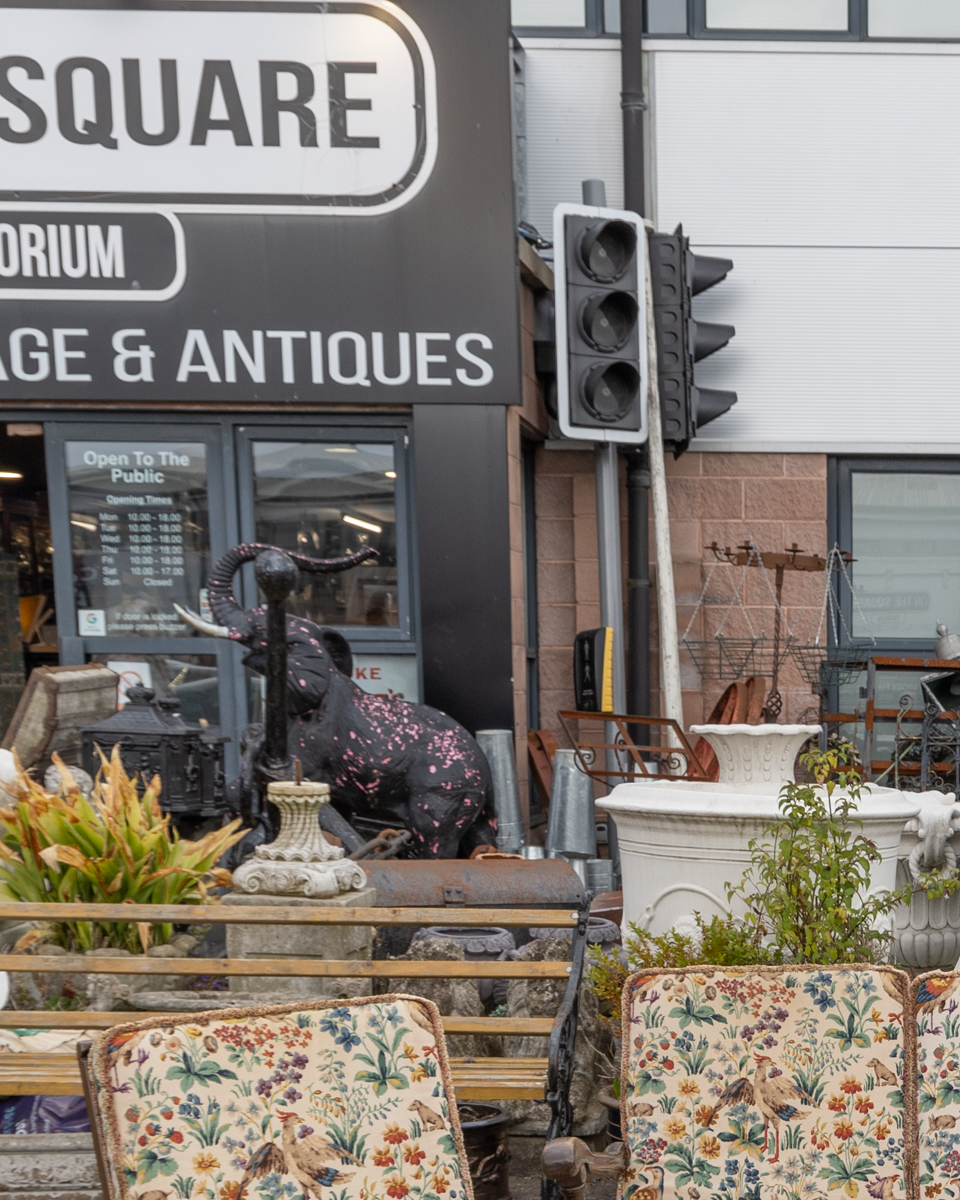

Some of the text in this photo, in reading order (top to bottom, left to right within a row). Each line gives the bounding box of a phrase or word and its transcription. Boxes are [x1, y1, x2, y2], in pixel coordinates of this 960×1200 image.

[0, 56, 381, 150] SQUARE
[111, 328, 155, 382] &
[176, 329, 494, 387] ANTIQUES
[83, 450, 190, 469] Open To The
[111, 468, 165, 484] Public
[106, 494, 173, 506] Opening Times
